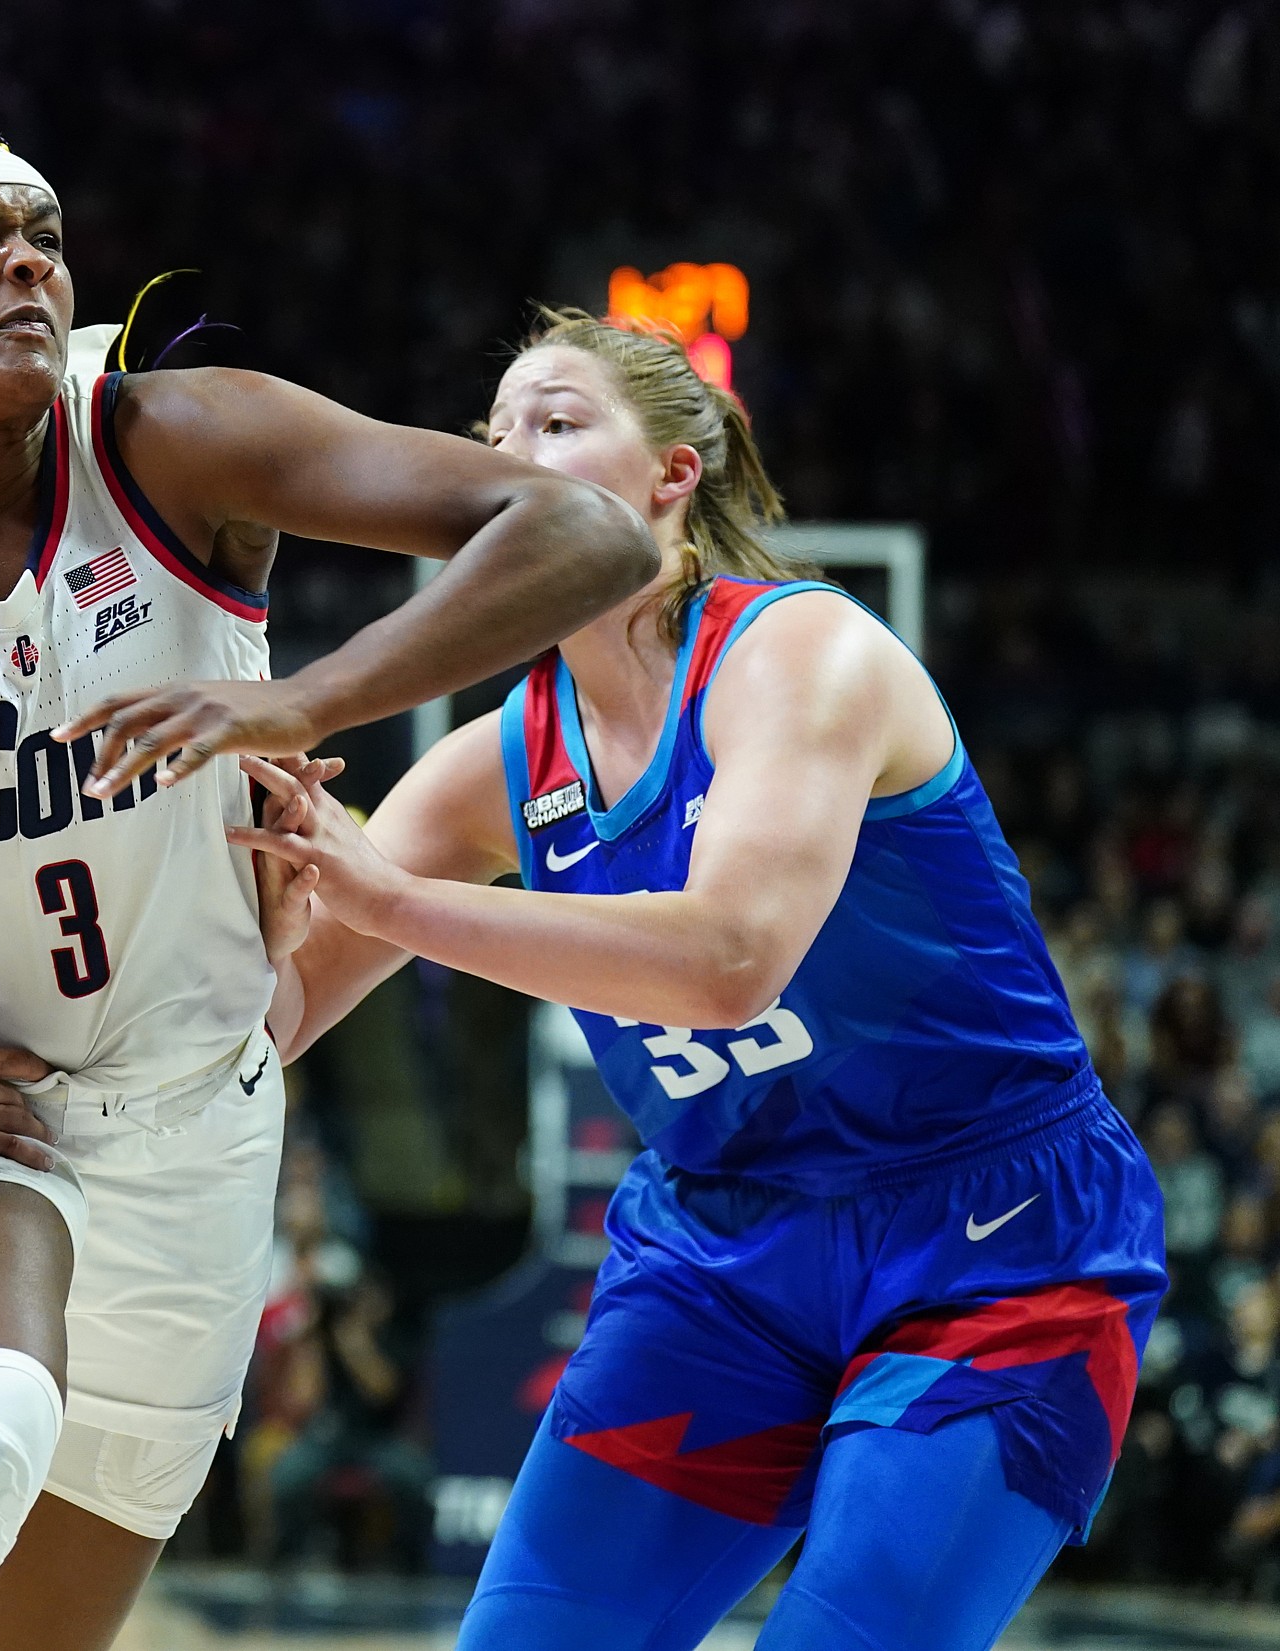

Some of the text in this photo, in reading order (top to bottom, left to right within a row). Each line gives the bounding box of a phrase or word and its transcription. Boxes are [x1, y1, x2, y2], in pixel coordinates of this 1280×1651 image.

[95, 594, 136, 627] BIG
[95, 602, 152, 642] EAST
[527, 795, 585, 829] CHANGE
[35, 858, 111, 998] 3
[613, 995, 814, 1100] 33
